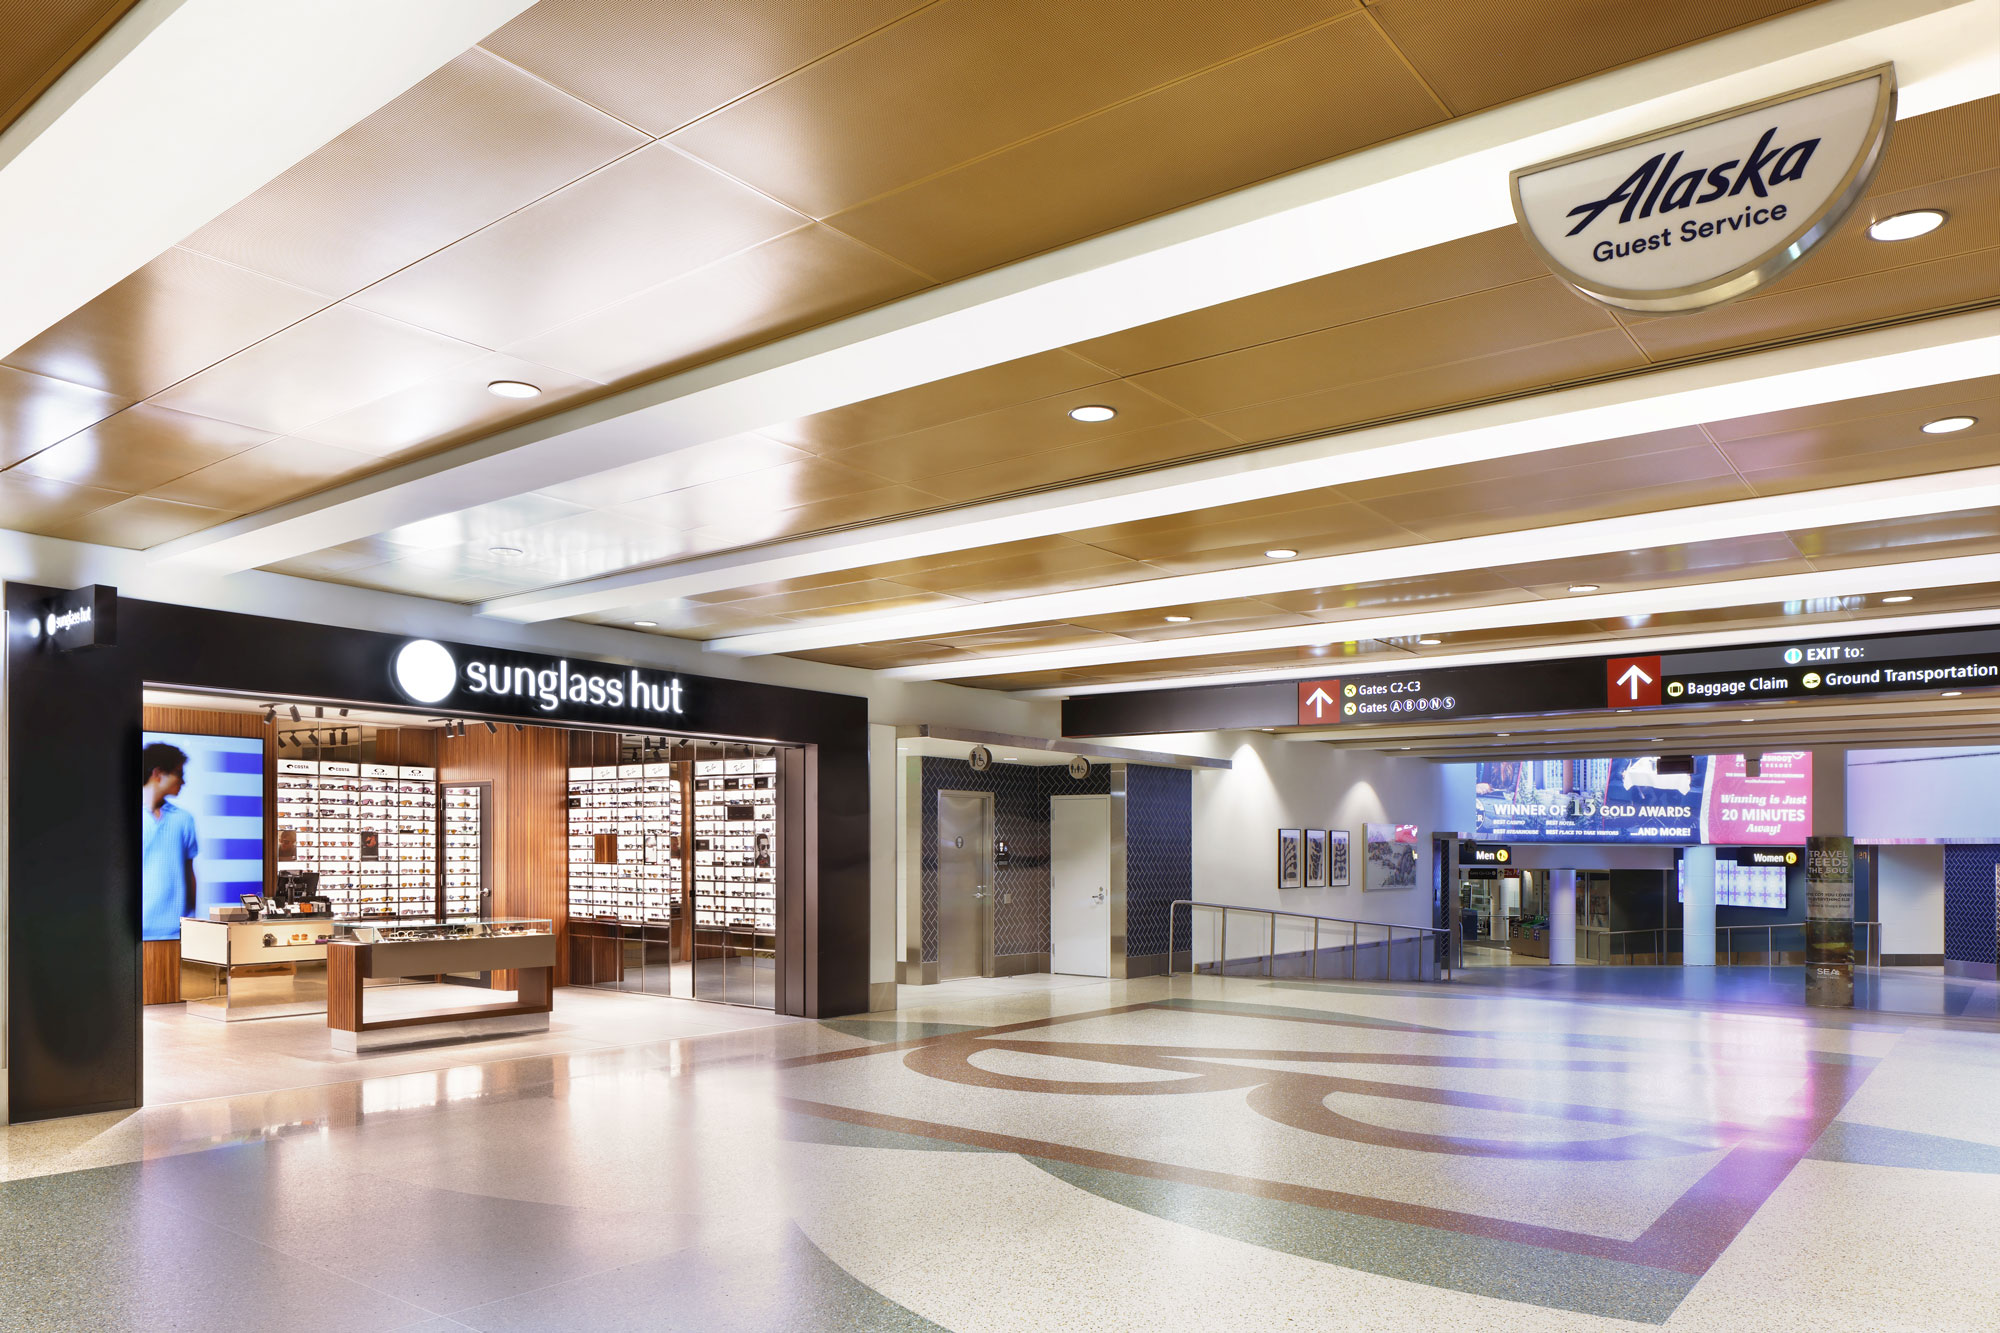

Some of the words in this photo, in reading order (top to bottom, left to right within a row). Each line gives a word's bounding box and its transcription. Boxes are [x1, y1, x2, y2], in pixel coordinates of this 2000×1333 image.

[1565, 126, 1822, 237] Alaska
[1593, 228, 1672, 263] Guest
[1680, 203, 1788, 242] Service
[1807, 647, 1840, 661] EXIT
[1845, 647, 1864, 658] to:
[1826, 670, 1880, 686] Ground
[1884, 664, 1998, 683] Transportation
[467, 660, 623, 711] sunglass
[631, 670, 683, 714] hut
[1359, 685, 1388, 695] Gates
[1390, 681, 1420, 693] C2-C3
[1688, 682, 1746, 696] Baggage
[1750, 677, 1788, 690] Claim
[1359, 703, 1388, 713] Gates
[1721, 794, 1767, 806] Winning
[1770, 794, 1780, 804] is
[1782, 795, 1807, 804] Just
[1494, 804, 1546, 816] WINNER
[1550, 805, 1567, 816] OF
[1571, 798, 1596, 816] 13
[1600, 806, 1636, 817] GOLD
[1638, 806, 1691, 817] AWARDS
[1722, 808, 1738, 820] 20
[1742, 808, 1806, 822] MINUTES
[1660, 828, 1691, 836] MORE!
[1746, 824, 1781, 836] Away!
[1476, 850, 1494, 860] Men
[1754, 853, 1784, 863] Women
[1809, 858, 1848, 866] FEEDS
